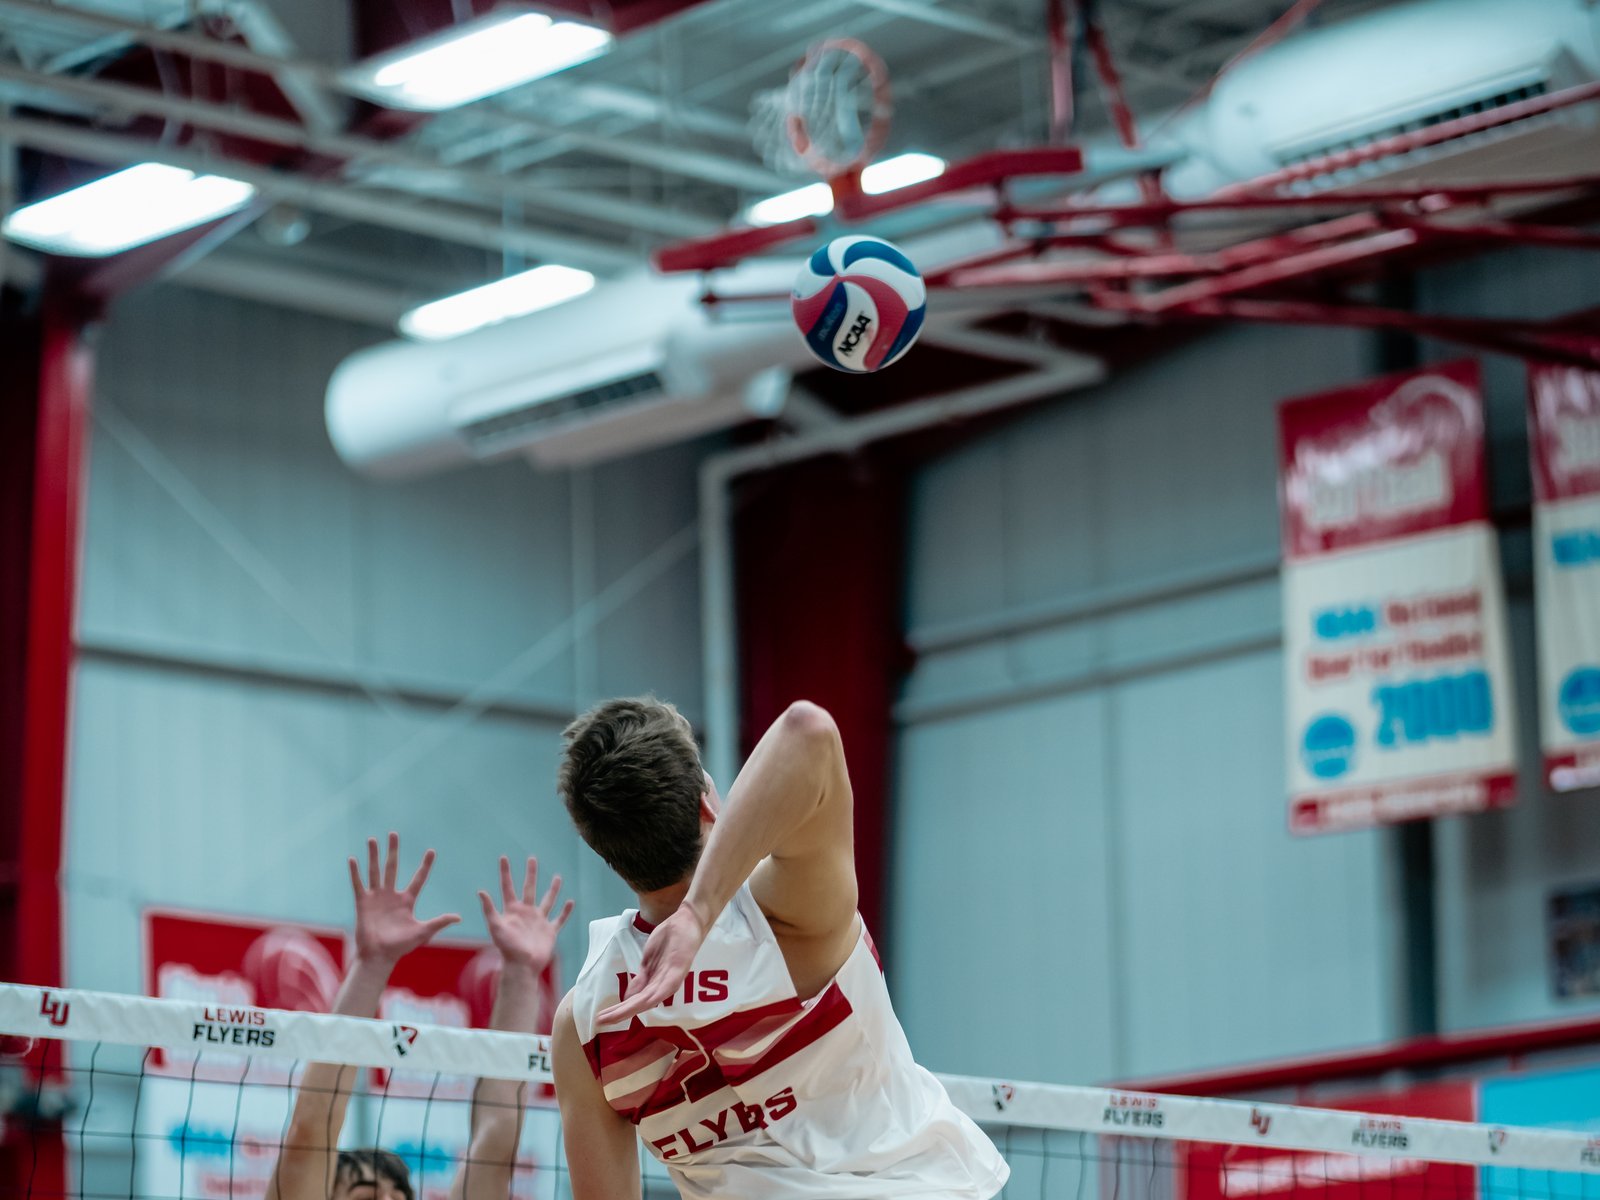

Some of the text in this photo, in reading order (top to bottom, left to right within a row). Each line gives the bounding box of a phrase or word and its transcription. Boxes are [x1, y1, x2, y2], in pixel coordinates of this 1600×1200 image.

[837, 314, 871, 357] NCAA
[615, 969, 729, 1008] LIS
[40, 991, 70, 1027] LU
[203, 1007, 265, 1026] LEWIS
[193, 1024, 275, 1047] FLYERS
[1109, 1094, 1157, 1109] LEWIS
[1103, 1108, 1165, 1128] FLYERS
[1351, 1130, 1408, 1150] FLYERS
